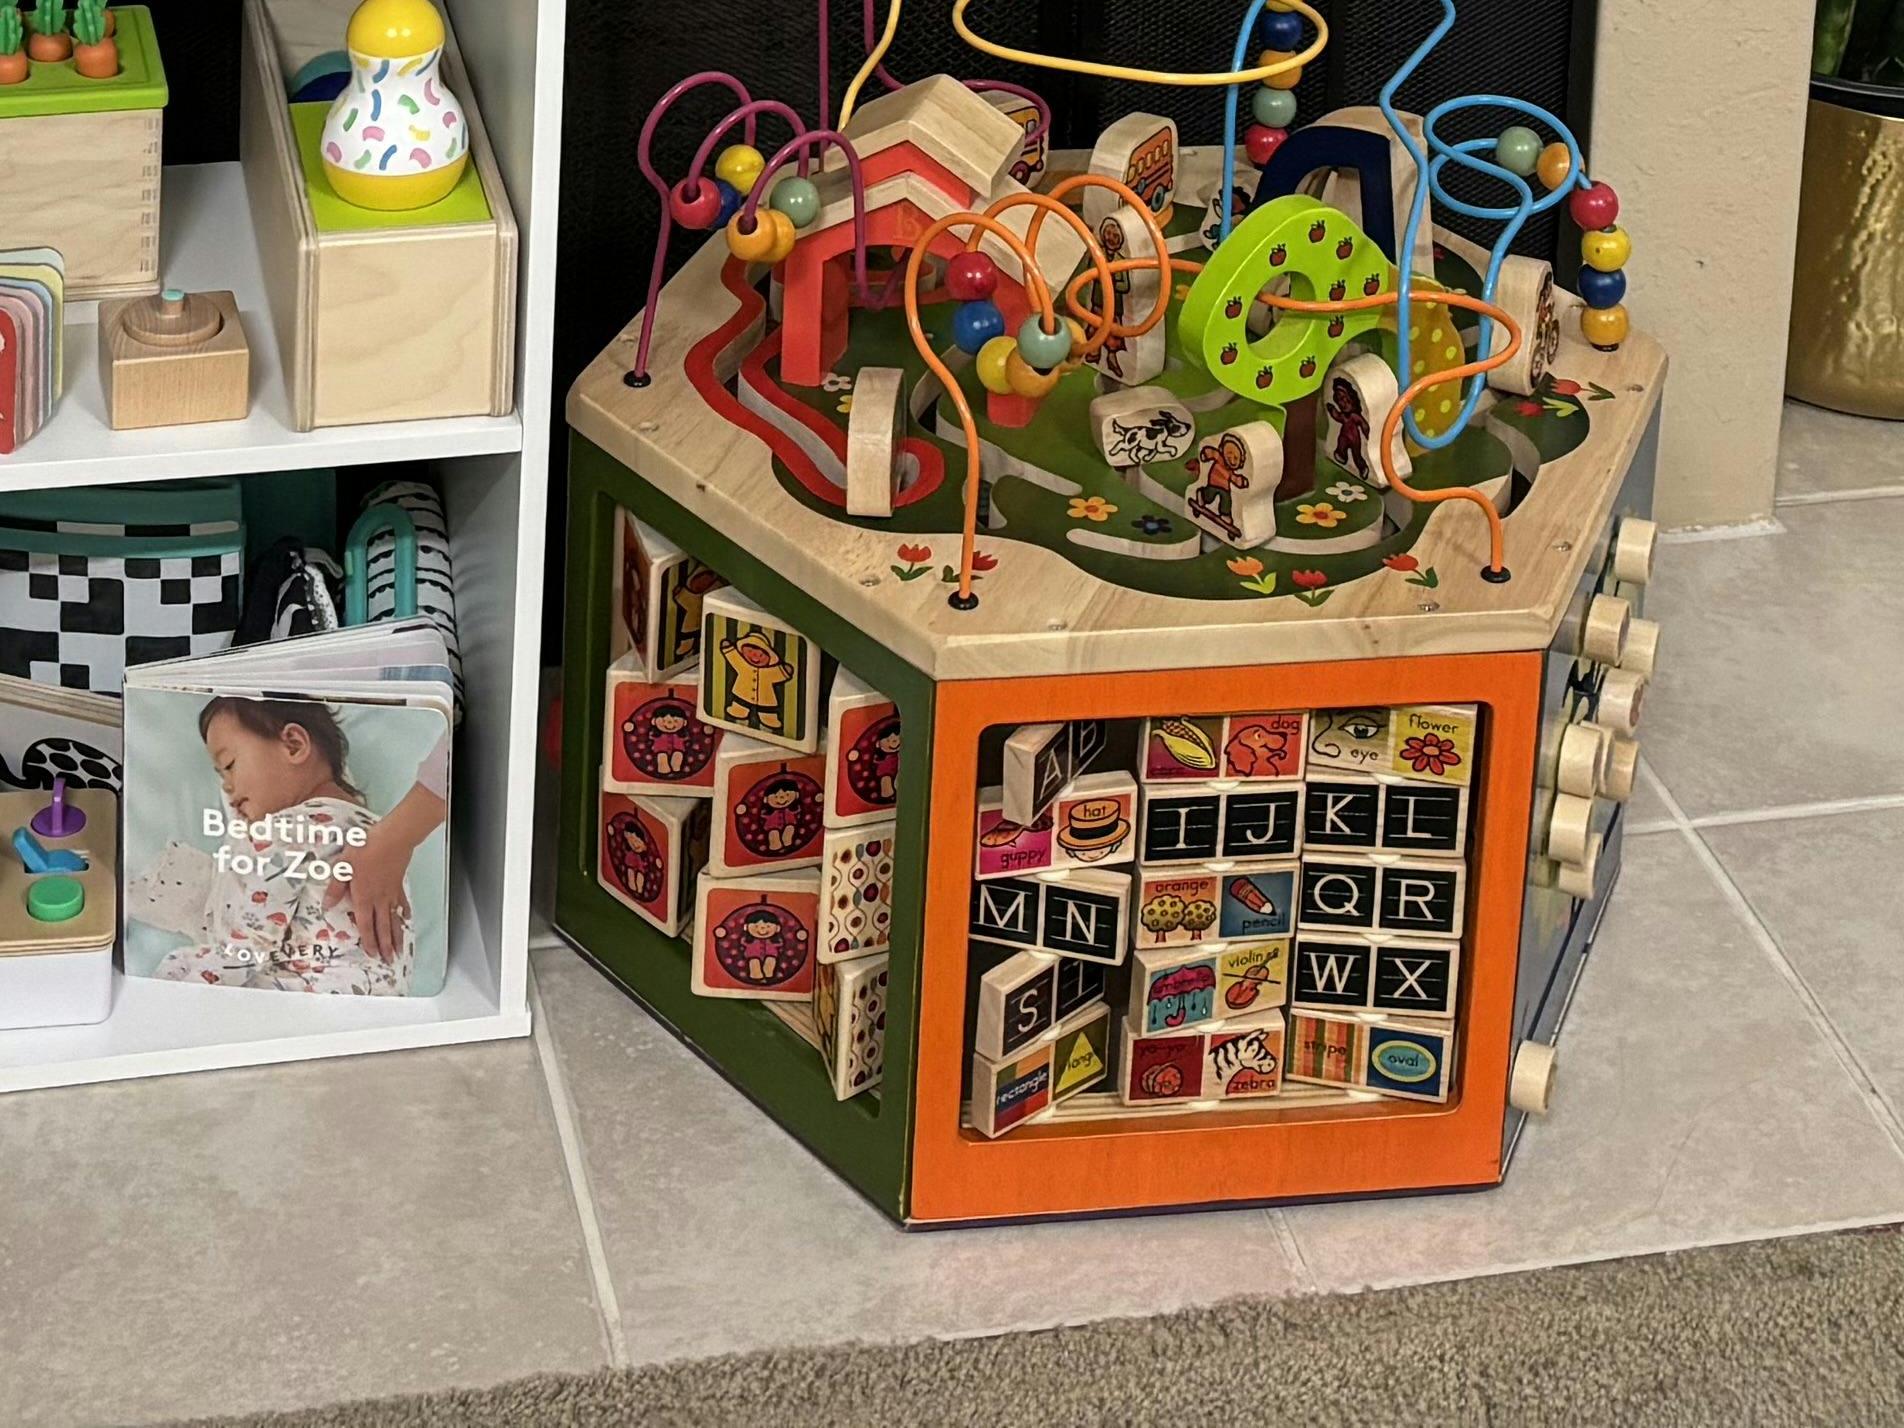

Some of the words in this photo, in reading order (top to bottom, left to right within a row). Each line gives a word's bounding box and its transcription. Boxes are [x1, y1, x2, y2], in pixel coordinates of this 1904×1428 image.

[1271, 714, 1300, 735] dog
[1409, 714, 1459, 734] flower
[1040, 748, 1062, 801] A
[1351, 749, 1378, 764] eye
[203, 808, 367, 847] Bedtime
[1084, 805, 1107, 818] hat
[1176, 808, 1190, 848] I
[1246, 804, 1275, 843] J
[1325, 794, 1354, 833] K
[1407, 797, 1433, 837] L
[213, 845, 271, 876] for
[283, 850, 353, 882] Zoe
[1000, 849, 1046, 869] guppy
[1155, 880, 1209, 896] orange
[1314, 874, 1360, 916] Q
[1399, 879, 1435, 920] R
[979, 884, 1025, 932] M
[1066, 900, 1096, 945] N
[1242, 912, 1285, 935] pencil
[224, 943, 339, 963] LOVEVERY
[1228, 952, 1263, 968] violin
[1309, 953, 1356, 993] W
[1392, 958, 1431, 999] X
[1018, 989, 1038, 1032] S
[1387, 1054, 1420, 1067] oval
[997, 1070, 1048, 1105] rectangle
[1232, 1073, 1276, 1091] zebra
